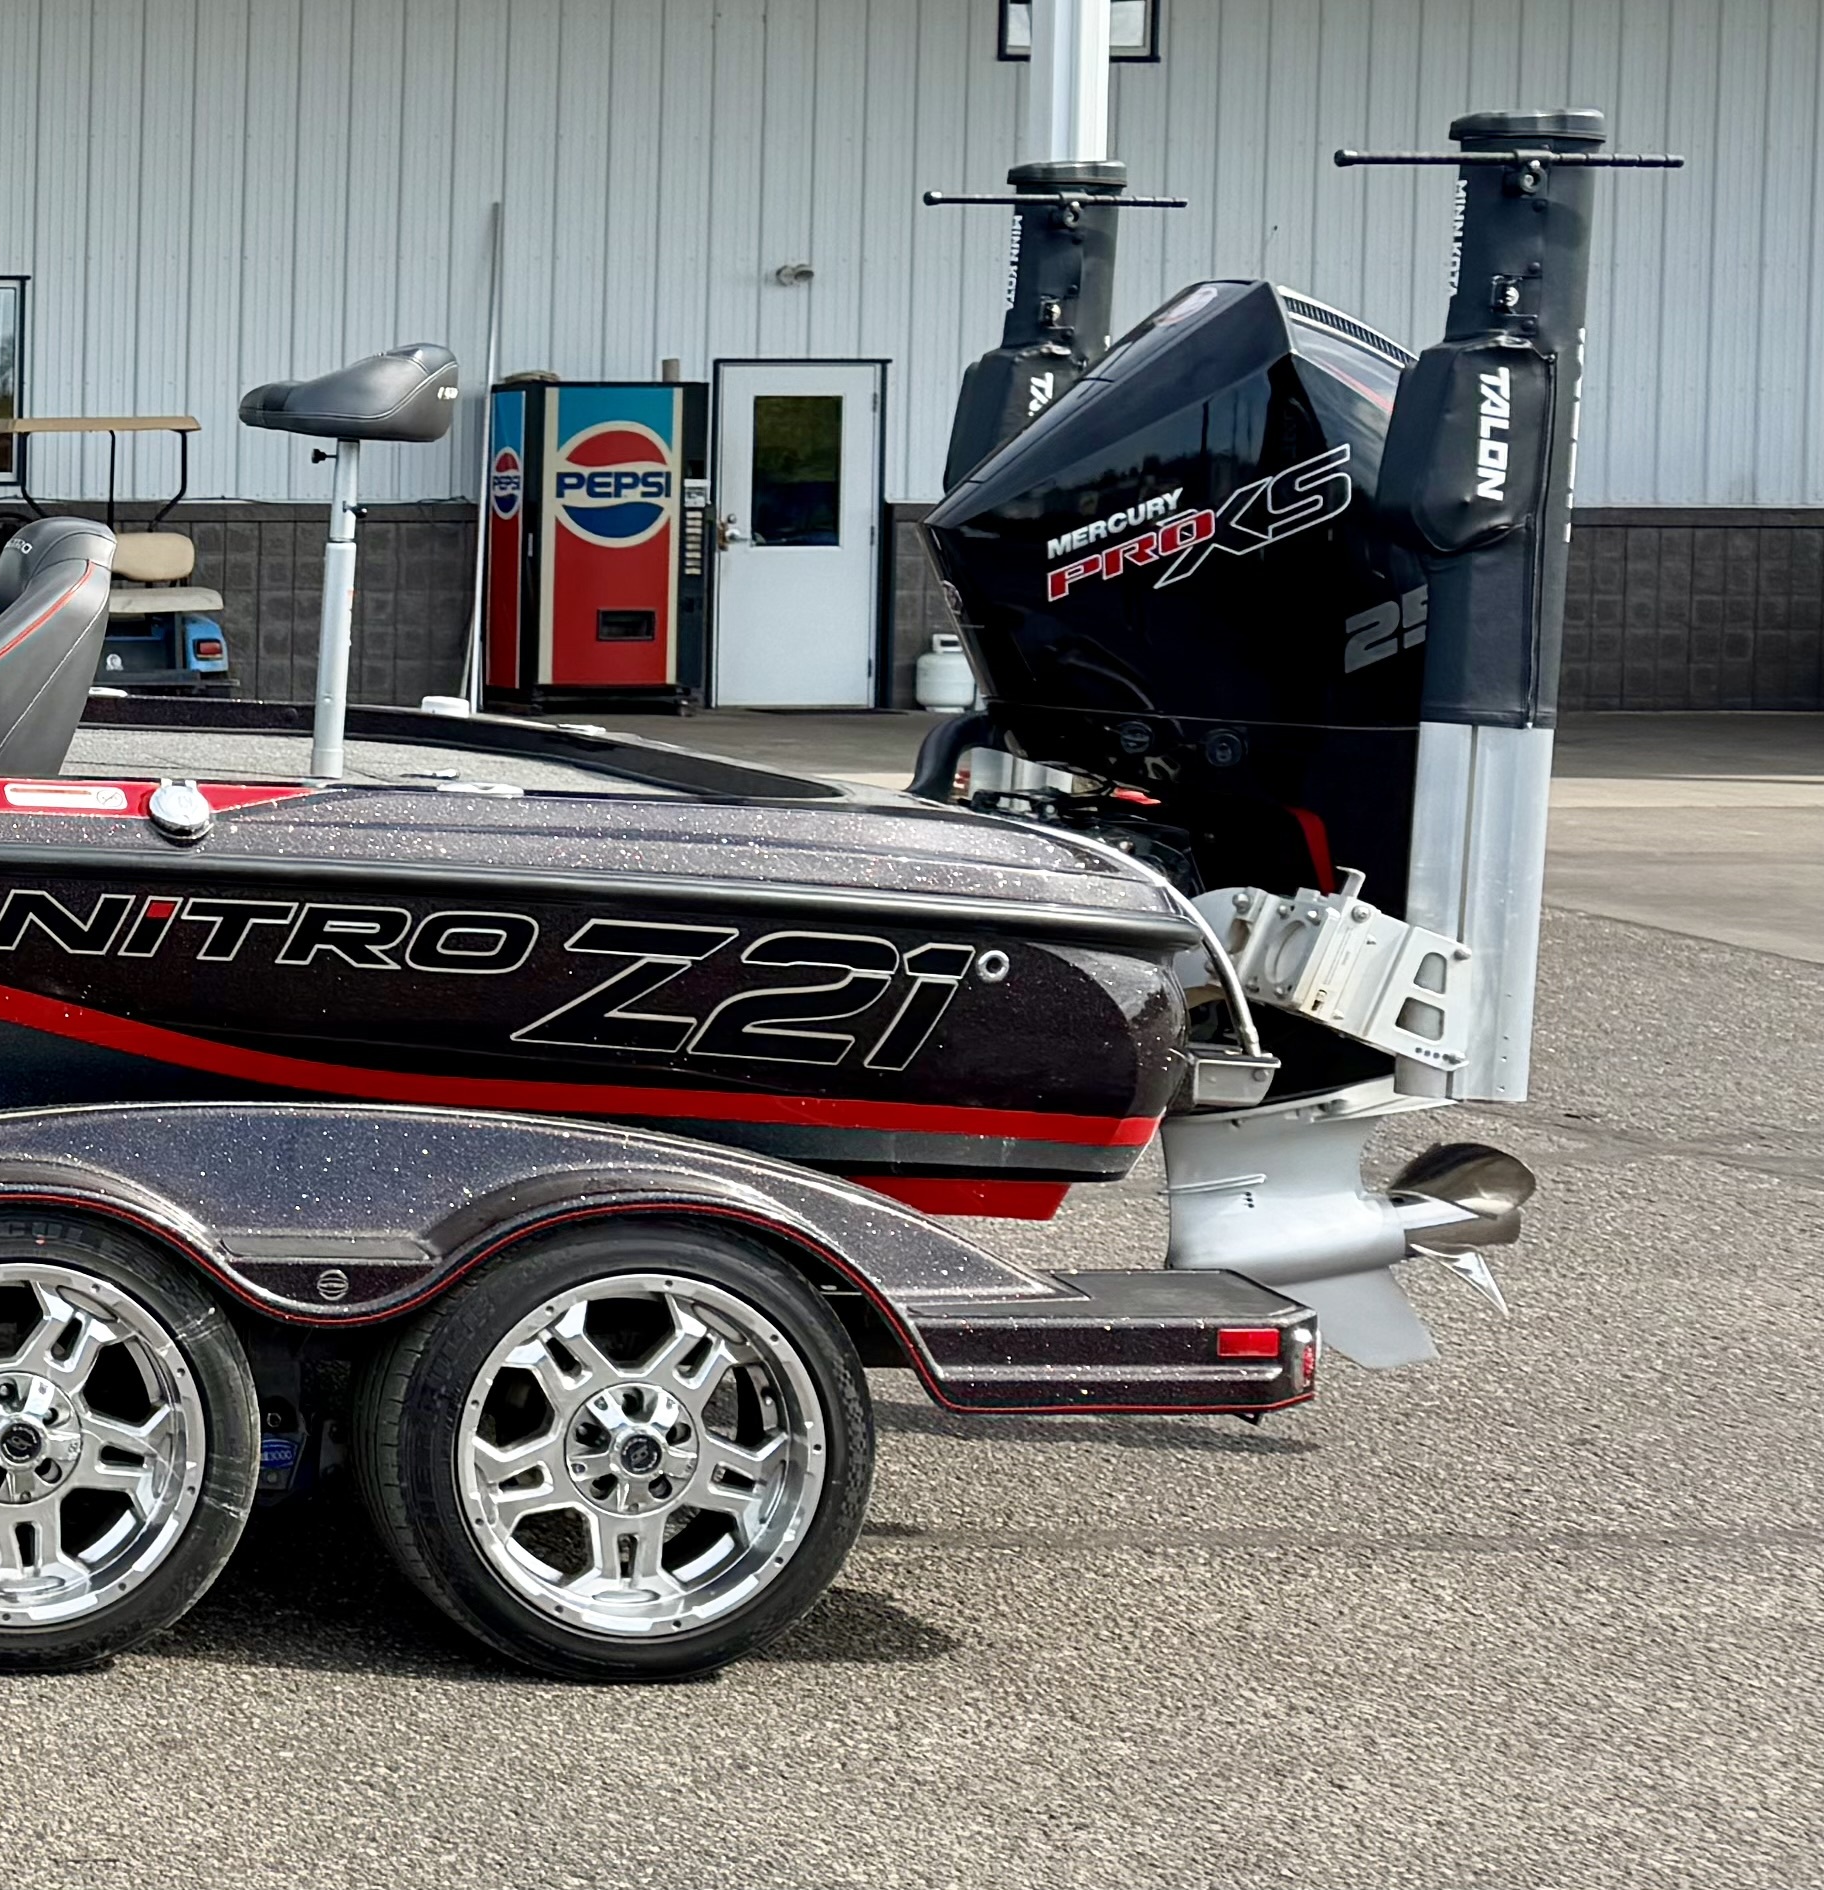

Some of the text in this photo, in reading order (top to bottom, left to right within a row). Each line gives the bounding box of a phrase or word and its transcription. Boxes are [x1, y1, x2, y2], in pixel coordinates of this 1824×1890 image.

[1477, 366, 1510, 501] TALON
[556, 471, 672, 498] PEPSI
[1047, 487, 1183, 559] MERCURY
